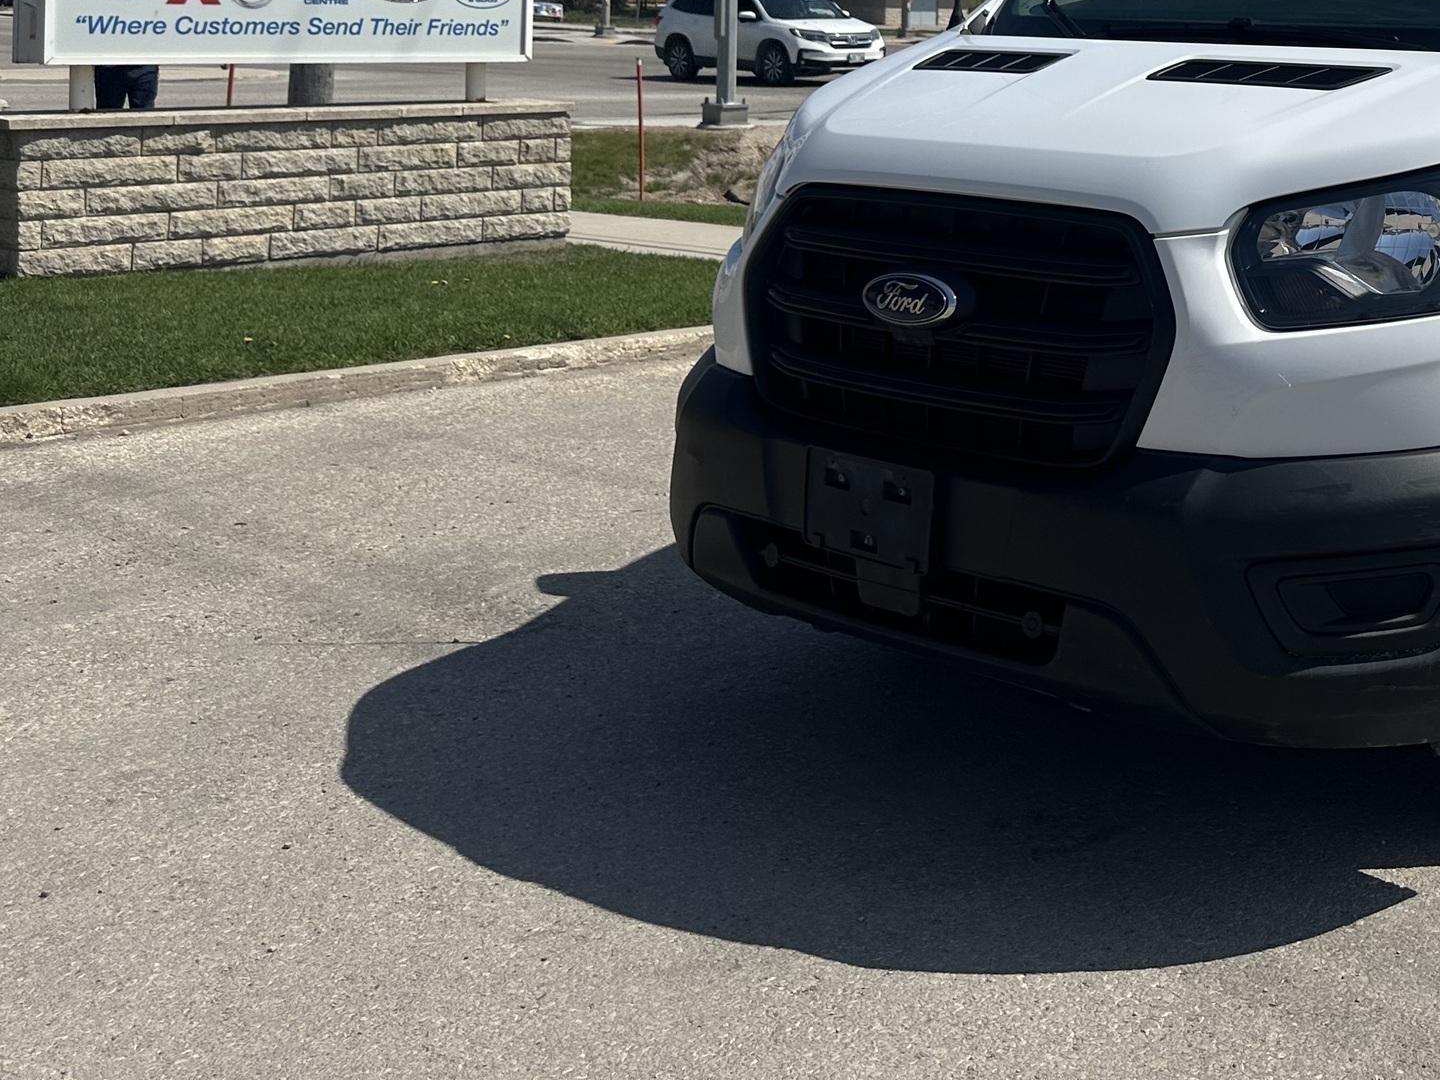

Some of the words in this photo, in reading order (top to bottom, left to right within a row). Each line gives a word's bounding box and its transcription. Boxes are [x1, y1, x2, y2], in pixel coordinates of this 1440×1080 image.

[175, 15, 300, 36] Customers
[307, 17, 363, 36] Send
[370, 18, 422, 36] Their
[876, 280, 928, 314] Ford
